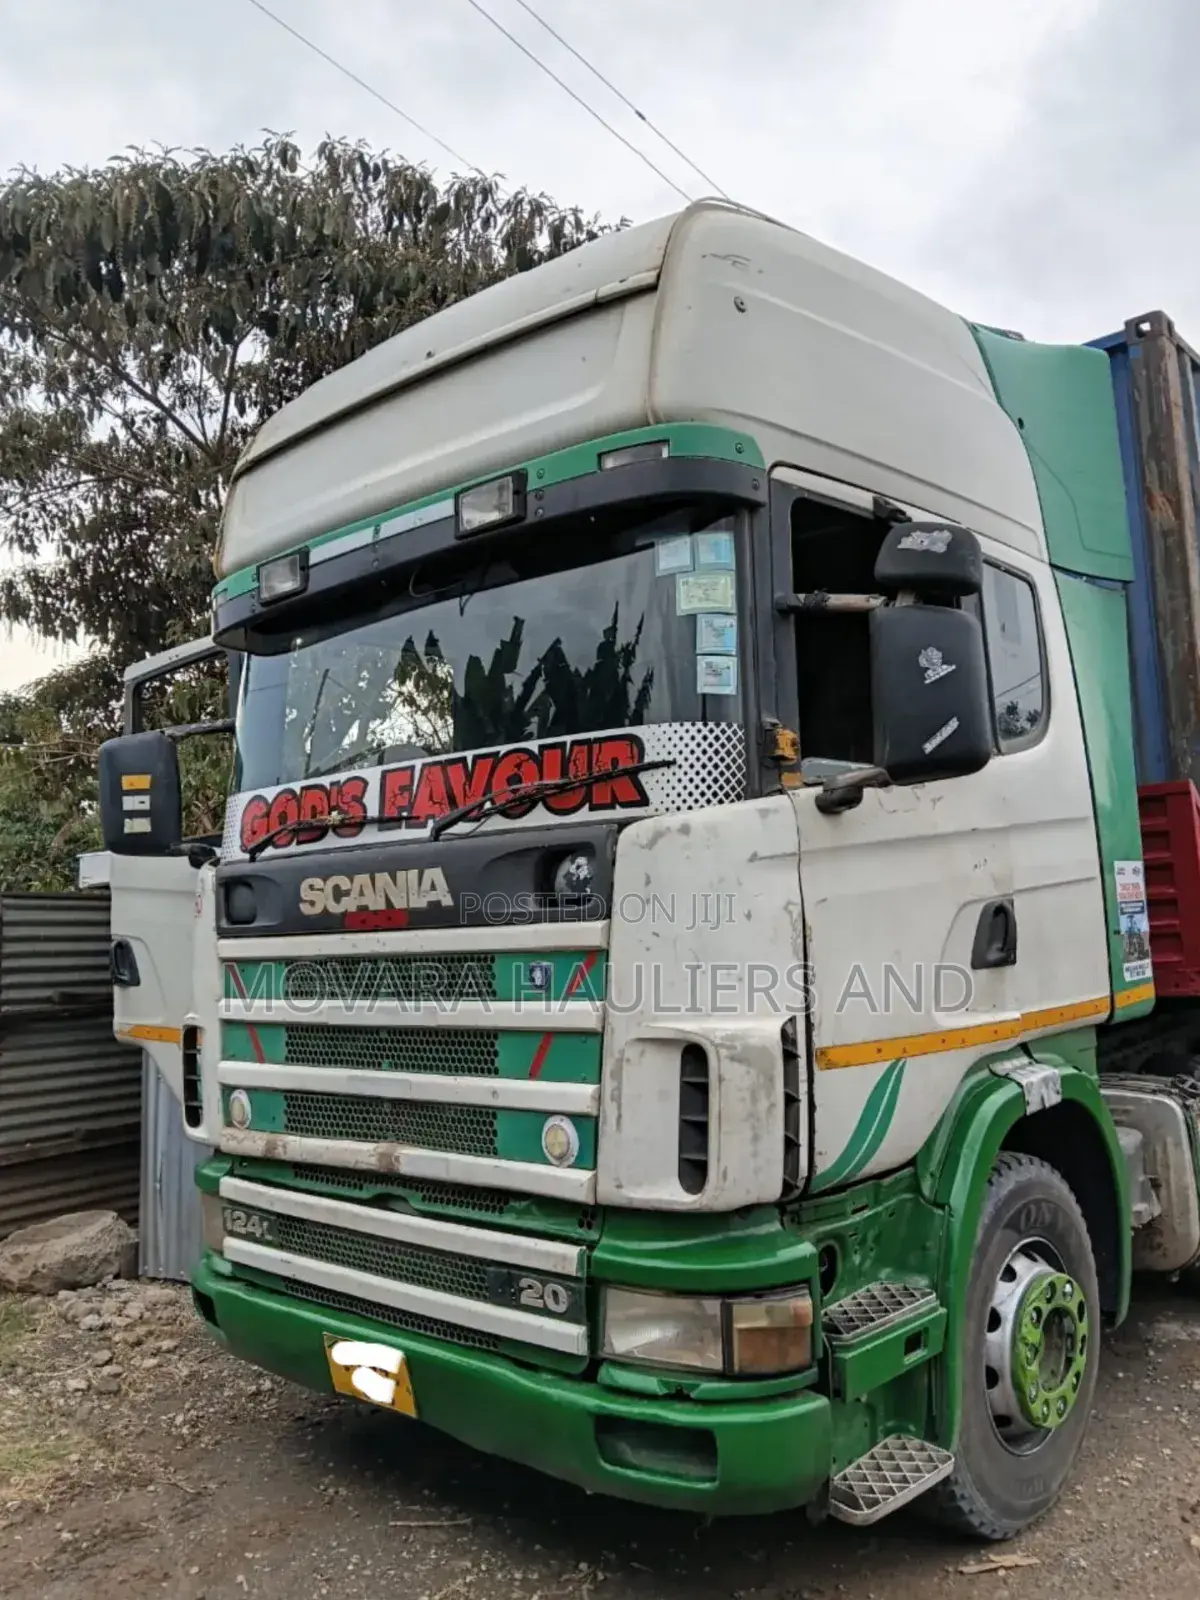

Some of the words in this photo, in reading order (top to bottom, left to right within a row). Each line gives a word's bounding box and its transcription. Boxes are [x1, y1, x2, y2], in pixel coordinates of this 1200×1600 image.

[241, 778, 368, 853] GOD'S
[379, 734, 649, 829] FAVOUR
[299, 867, 454, 915] SCANIA
[519, 1277, 568, 1313] 20
